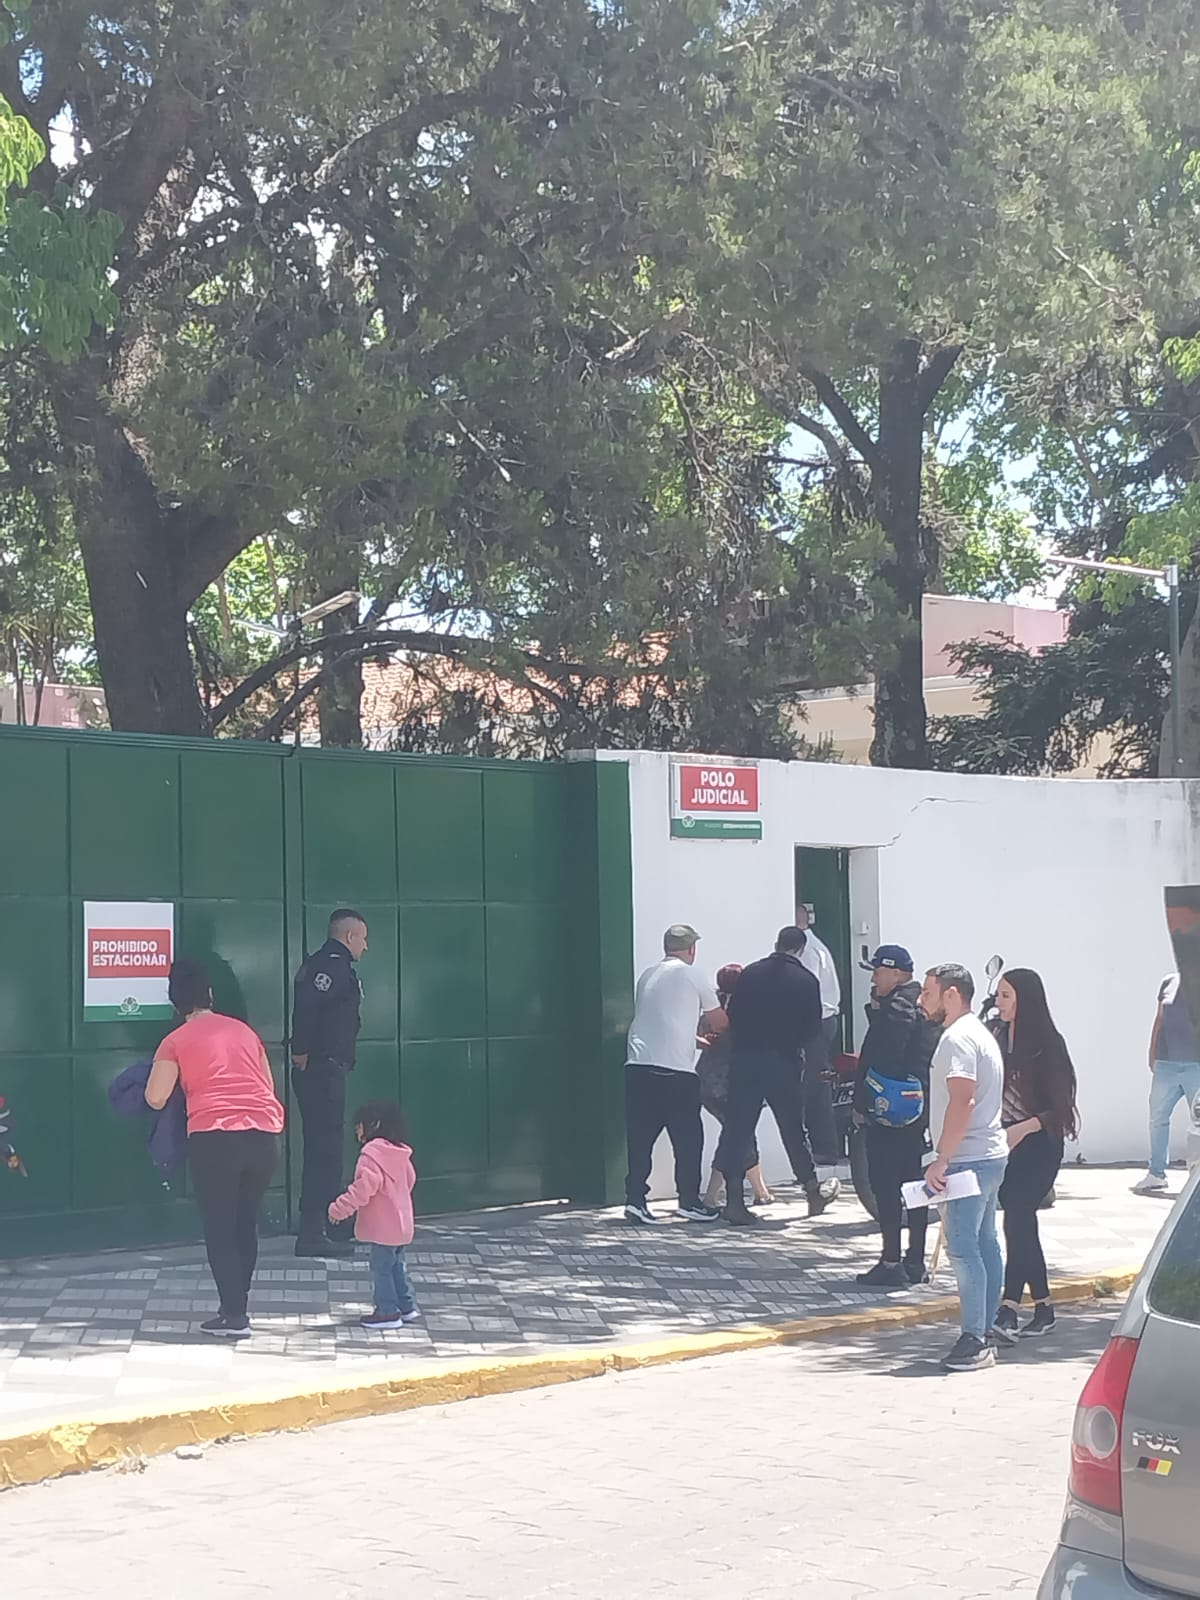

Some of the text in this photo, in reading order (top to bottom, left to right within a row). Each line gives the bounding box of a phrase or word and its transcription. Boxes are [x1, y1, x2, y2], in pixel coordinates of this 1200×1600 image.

[700, 771, 735, 787] POLO
[691, 788, 749, 805] JUDICIAL
[92, 941, 157, 953] PROHIBIDO
[92, 954, 167, 966] ESTACIONAR
[1132, 1431, 1181, 1455] FOX
